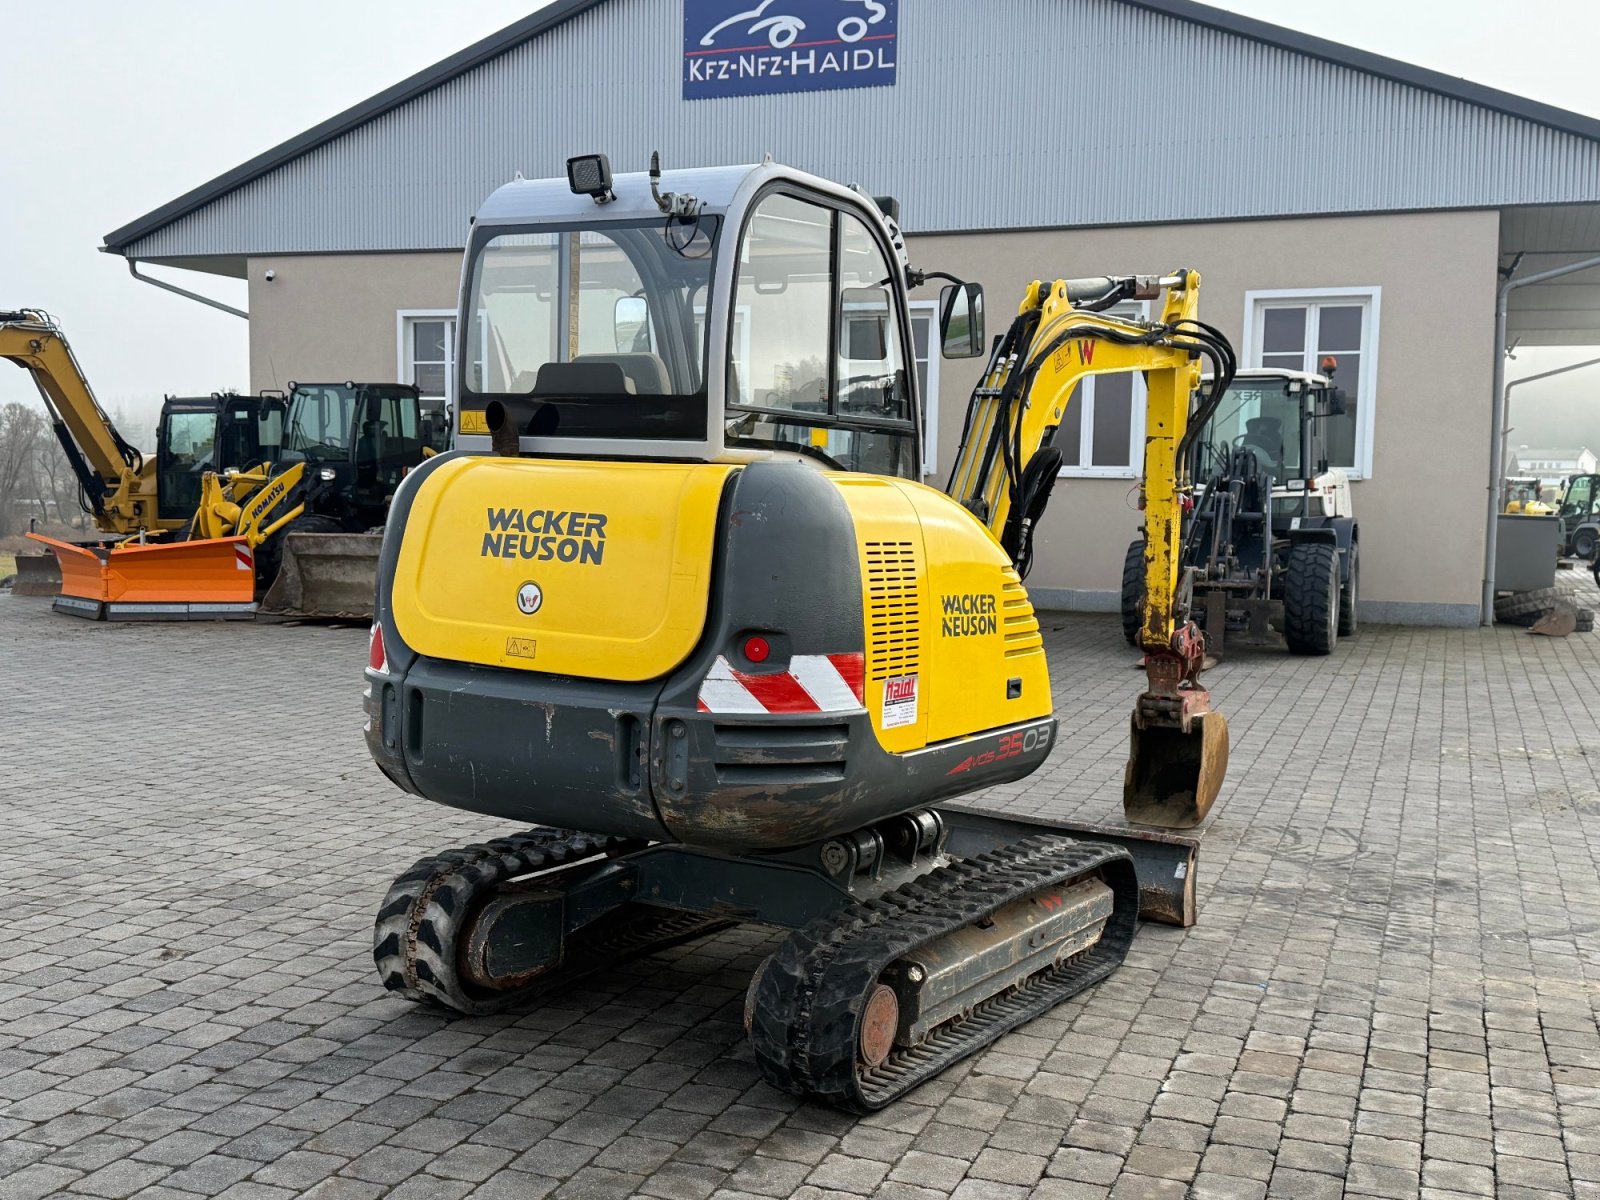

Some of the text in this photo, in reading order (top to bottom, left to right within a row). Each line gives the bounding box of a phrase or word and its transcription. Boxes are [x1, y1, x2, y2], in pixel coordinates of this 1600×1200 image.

[252, 482, 285, 519] KOMATSU
[487, 507, 608, 539] WACKER
[481, 533, 605, 566] NEUSON
[941, 594, 997, 614] WACKER
[942, 615, 996, 637] NEUSON
[995, 726, 1050, 760] 3503
